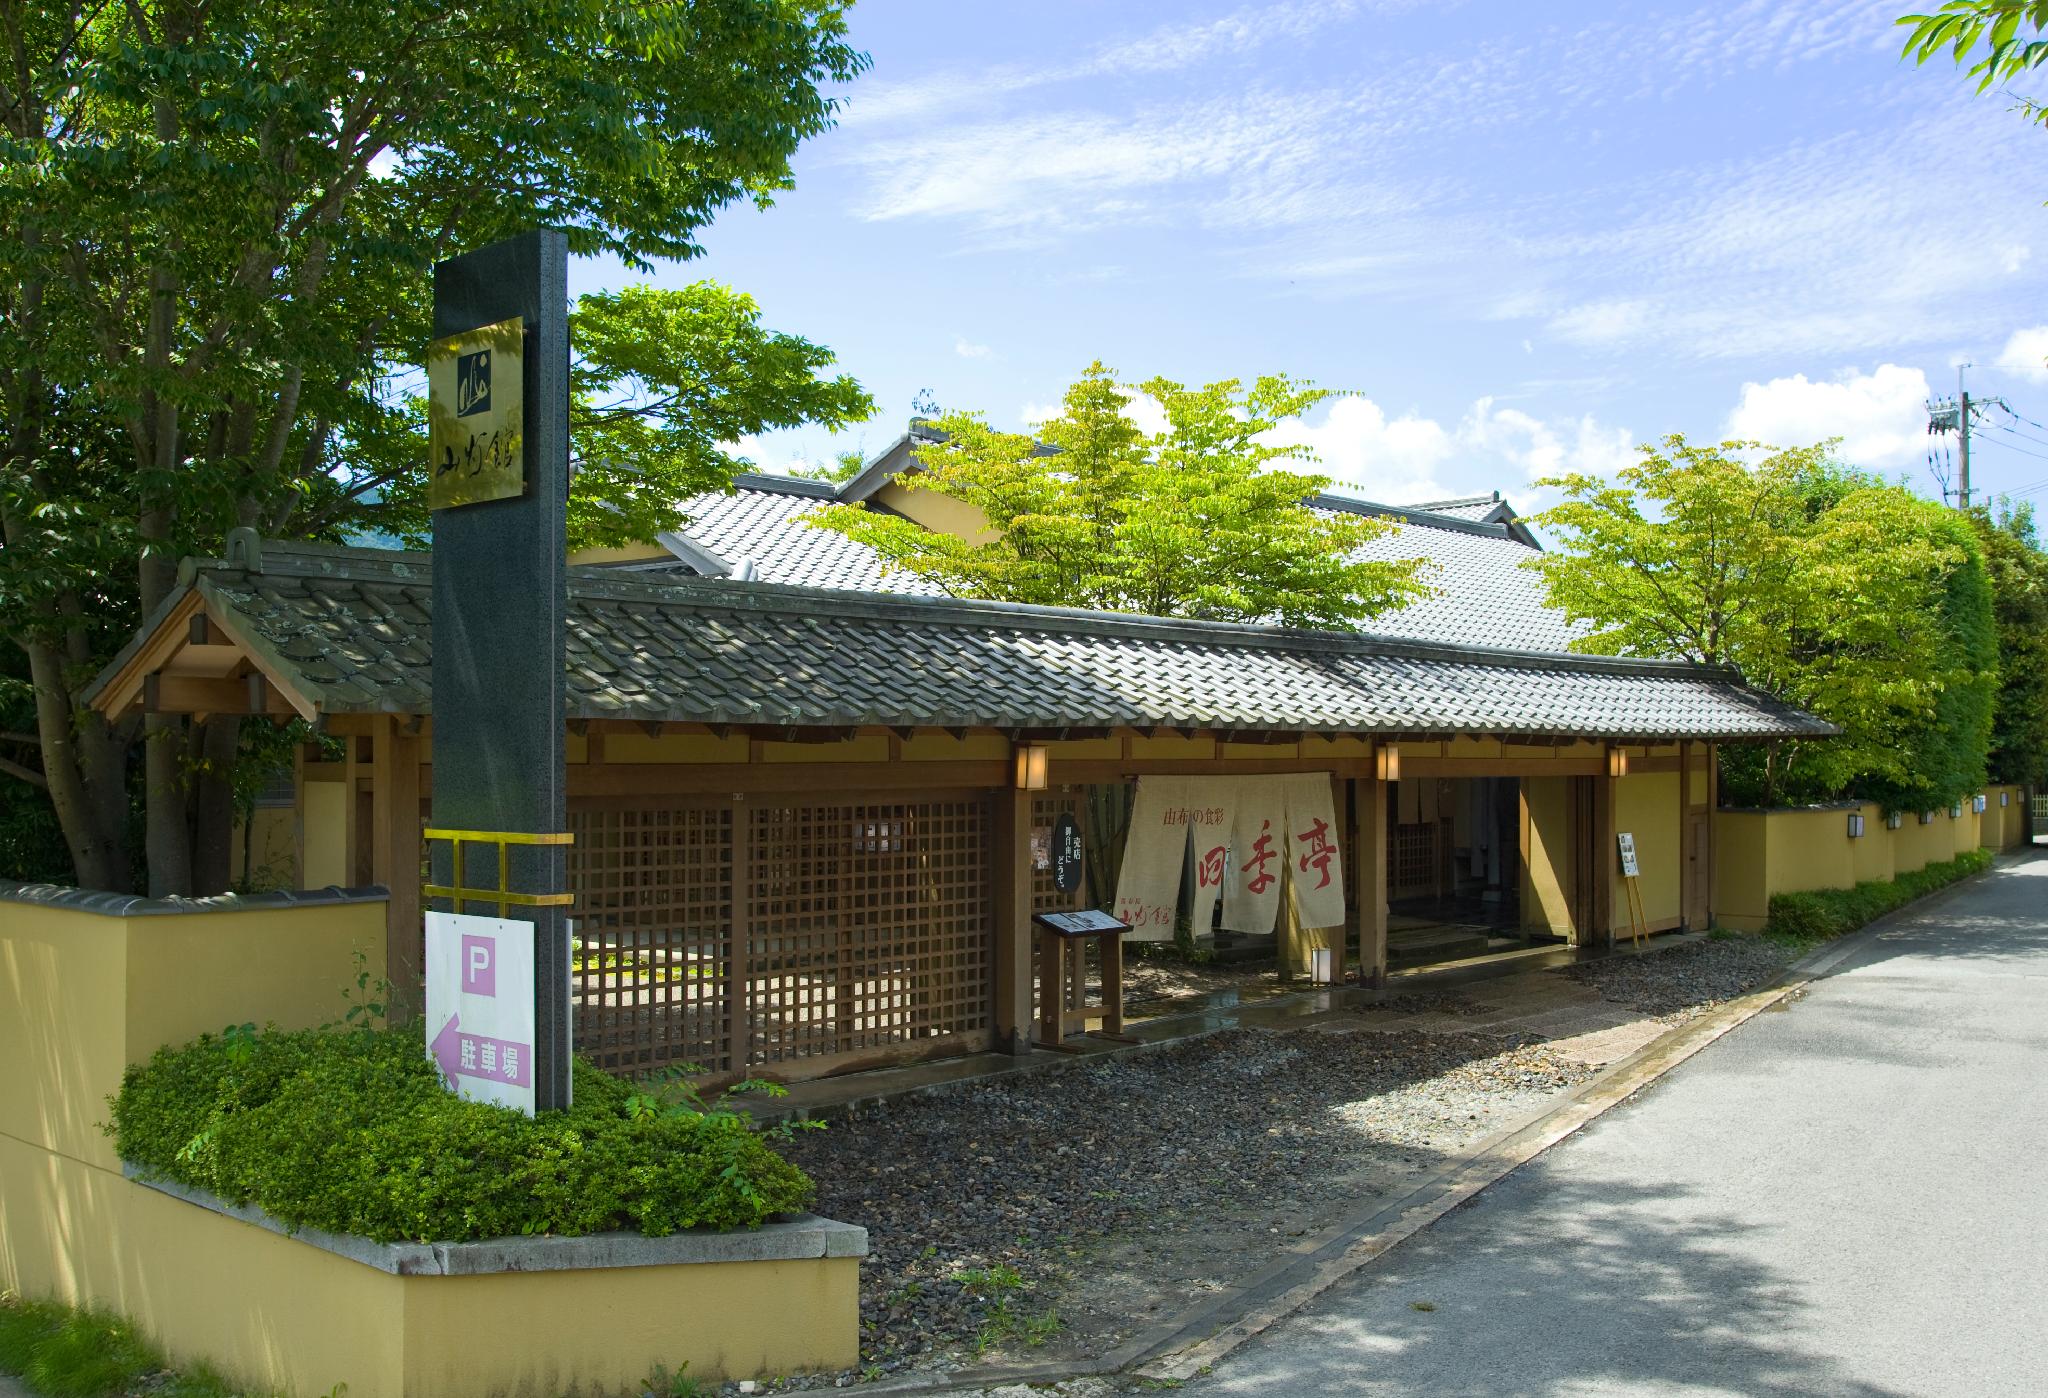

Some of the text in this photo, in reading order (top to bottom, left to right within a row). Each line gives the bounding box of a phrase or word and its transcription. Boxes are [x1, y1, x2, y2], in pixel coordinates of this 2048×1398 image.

[1199, 817, 1338, 895] 四季亭
[470, 946, 489, 984] P
[461, 1038, 518, 1080] 駐車場
